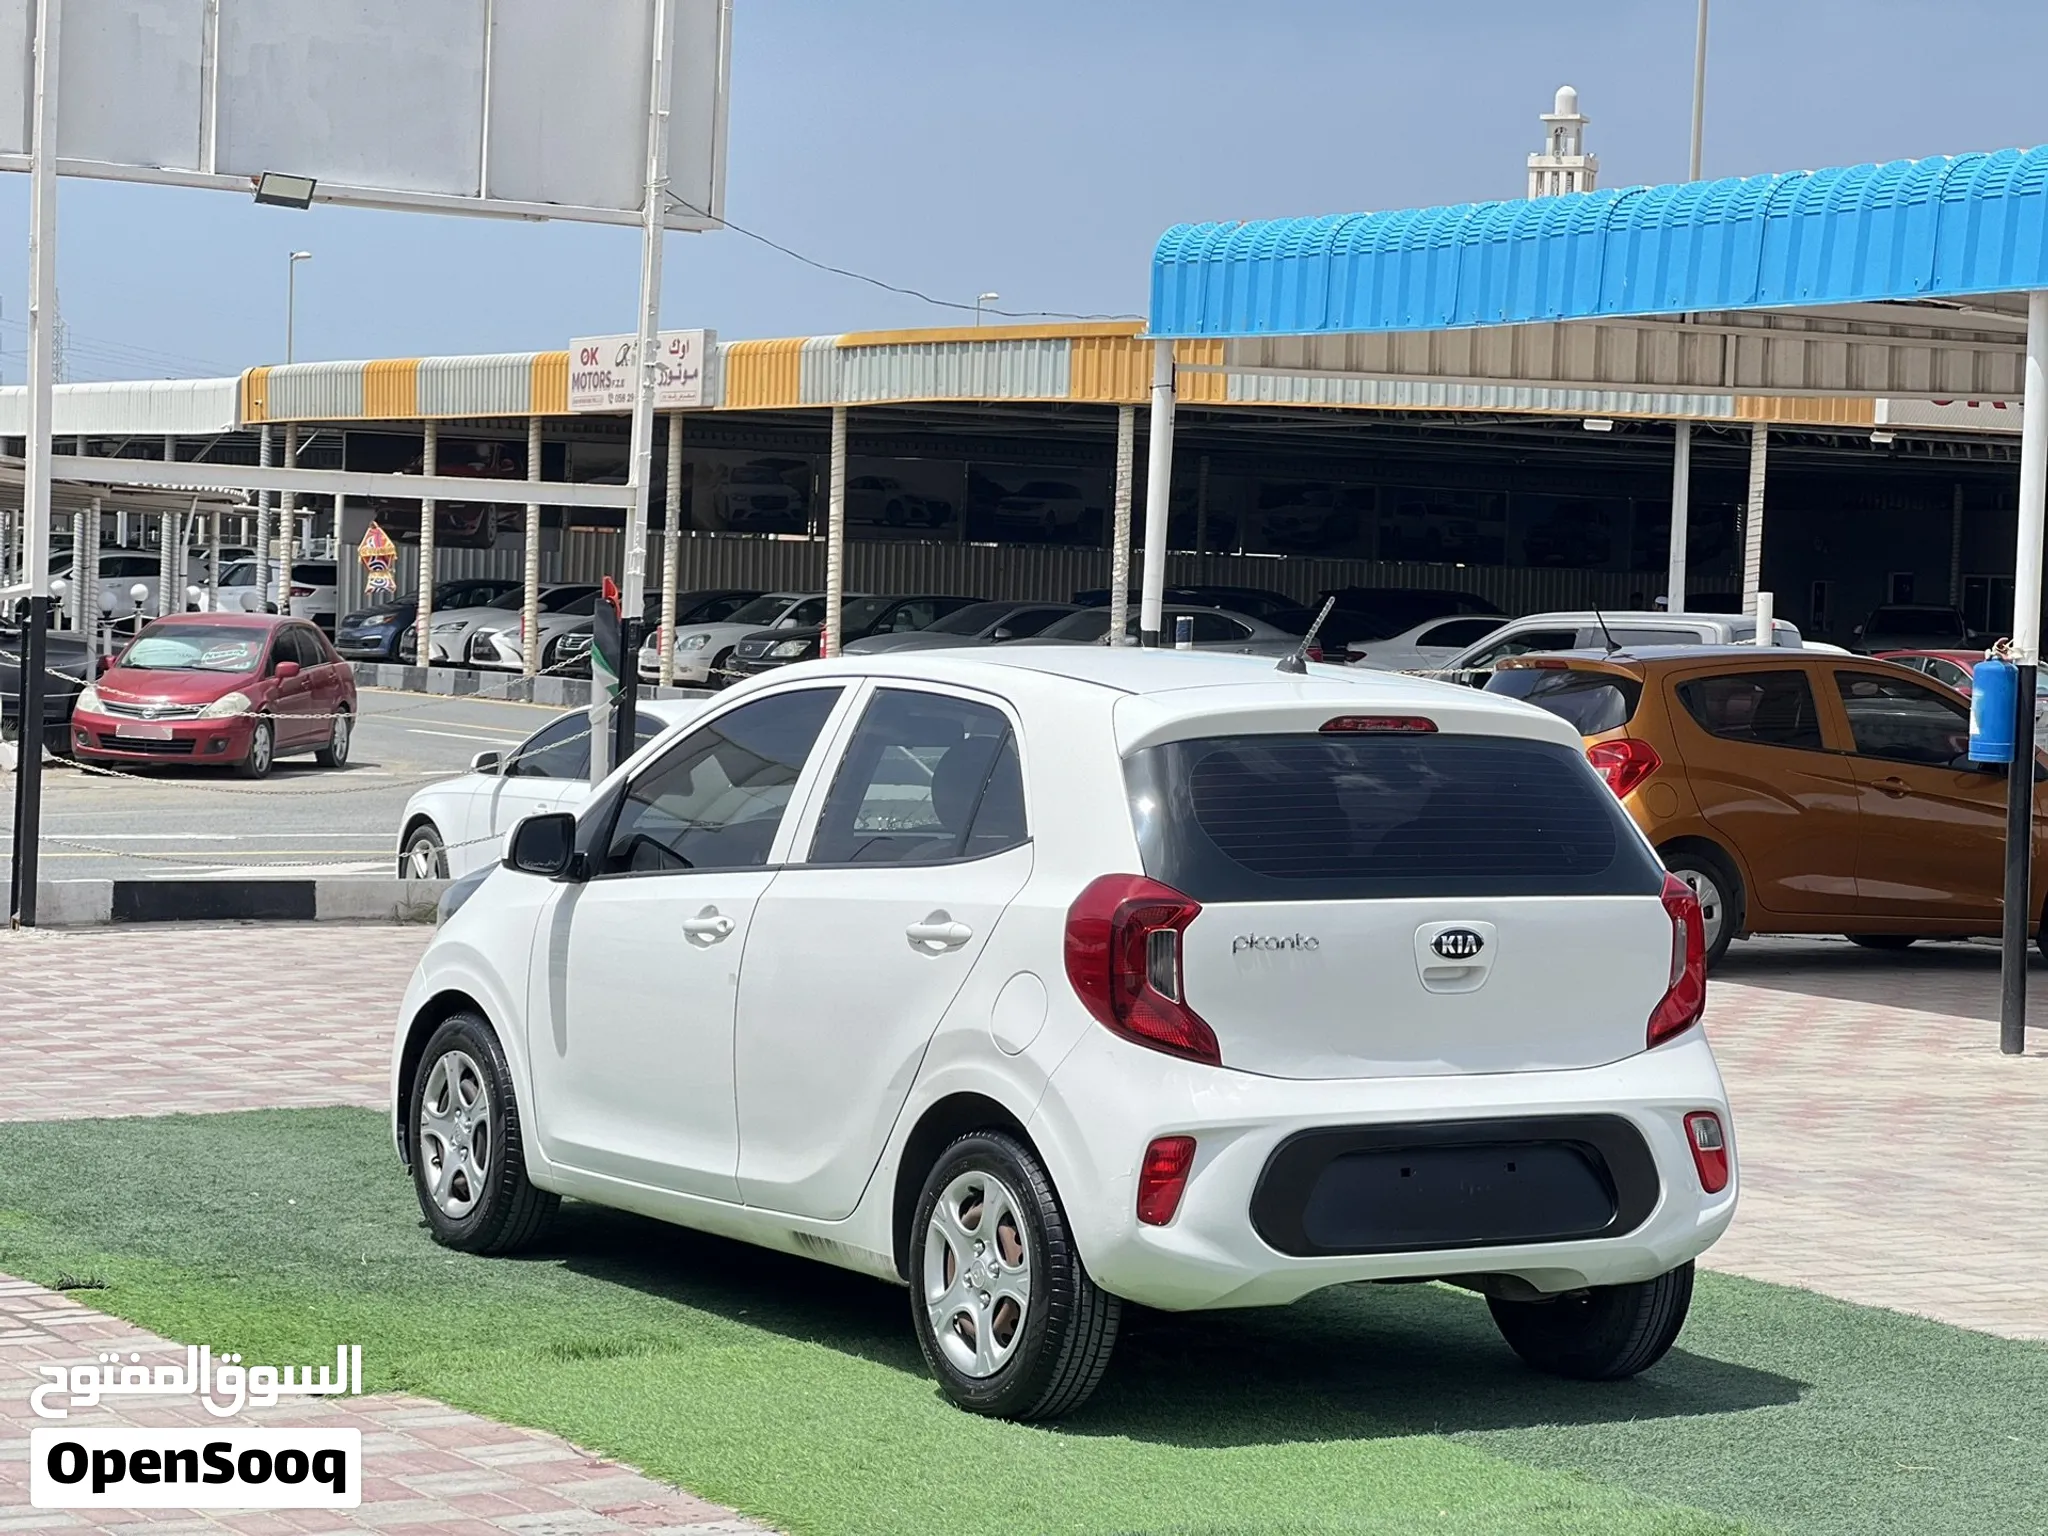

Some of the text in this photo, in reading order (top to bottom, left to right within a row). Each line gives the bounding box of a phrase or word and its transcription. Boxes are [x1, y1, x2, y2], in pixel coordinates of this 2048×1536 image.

[580, 346, 599, 366] OK
[572, 370, 612, 391] MOTORS
[1232, 932, 1320, 953] picanto
[1440, 935, 1478, 954] KIA
